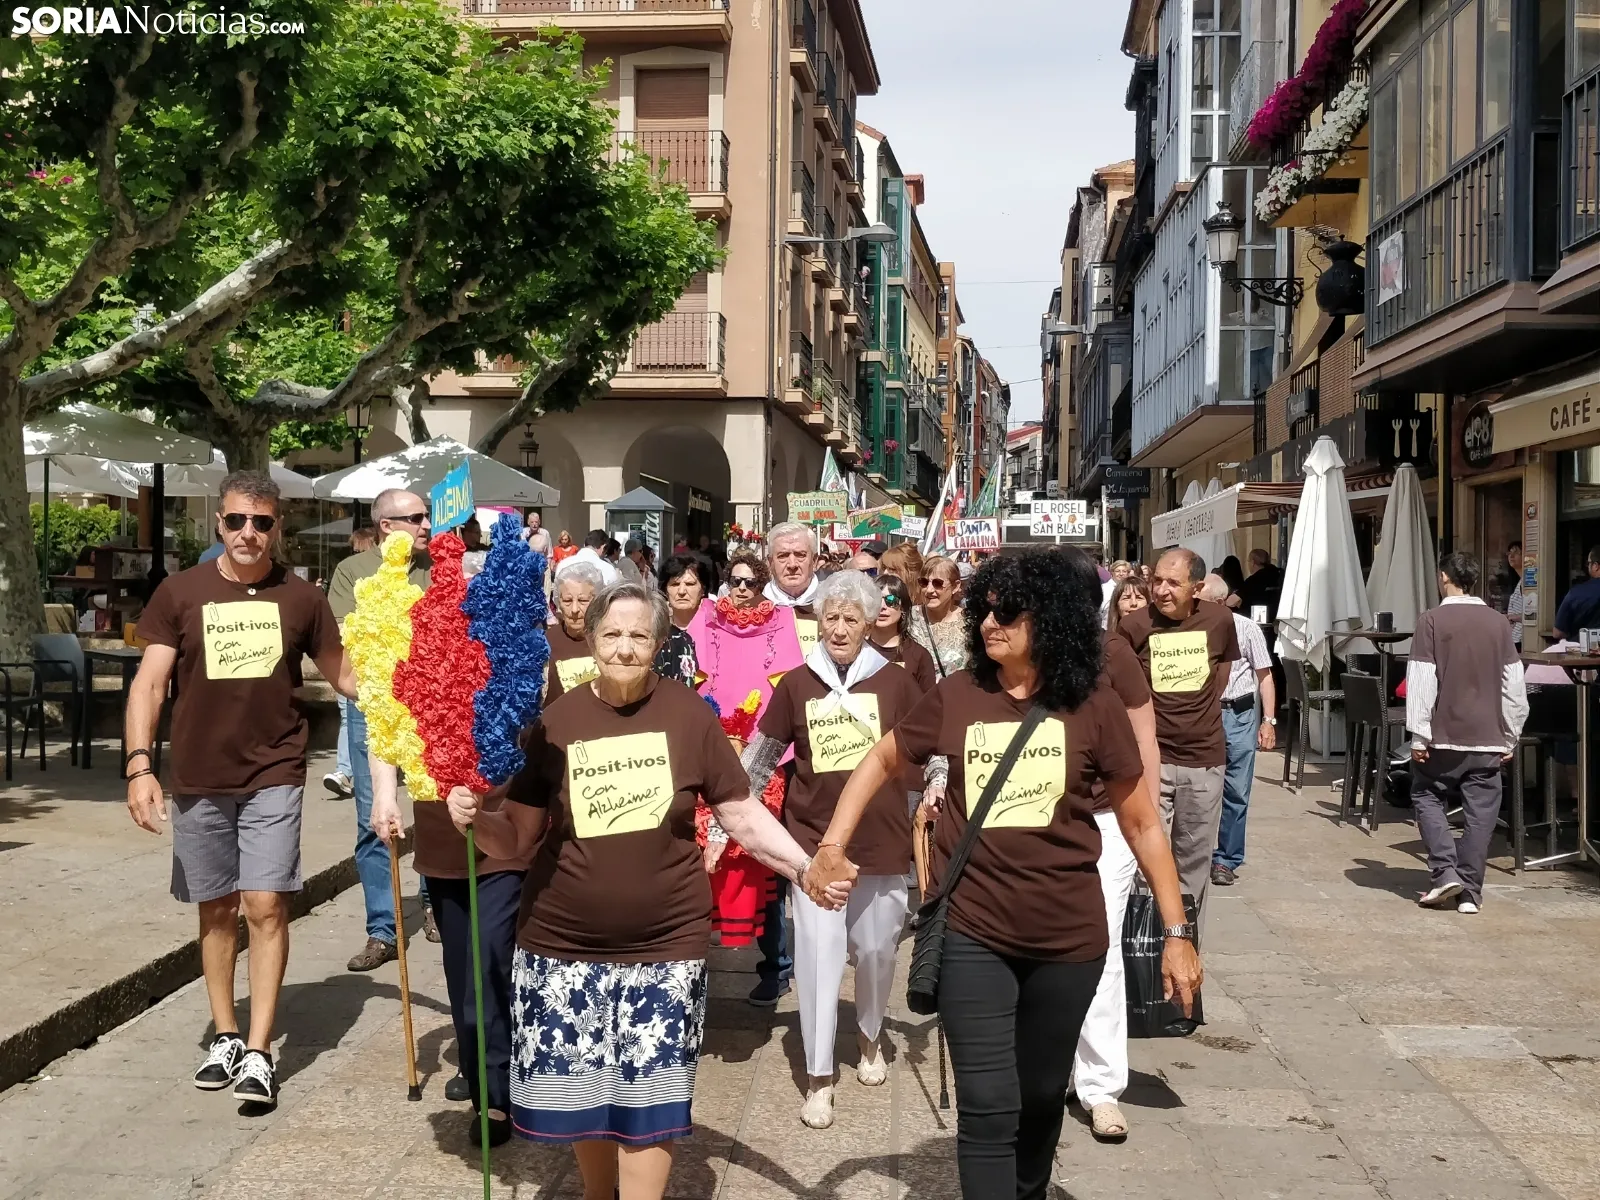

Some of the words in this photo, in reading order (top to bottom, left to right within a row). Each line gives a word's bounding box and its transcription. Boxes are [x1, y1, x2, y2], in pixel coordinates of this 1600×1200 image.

[1550, 392, 1591, 431] CAFÉ
[794, 499, 840, 508] CUADRILLA
[1033, 503, 1047, 513] EL
[1050, 502, 1084, 513] ROSEL
[957, 520, 992, 536] SANTA
[1033, 523, 1053, 534] SAN
[1057, 523, 1084, 534] BLAS
[954, 535, 997, 549] CATALINA
[206, 620, 279, 634] Posit-ivos
[214, 640, 242, 652] Con
[1152, 646, 1206, 658] Posit-ivos
[218, 646, 274, 667] Alzheimer
[1157, 662, 1178, 672] Con
[809, 712, 877, 730] Posit-is
[816, 733, 841, 745] Con
[820, 736, 873, 759] Alzheimer
[967, 746, 1063, 764] Pos-ivos
[572, 756, 667, 780] Posit-ivos
[582, 784, 618, 800] Con
[587, 786, 661, 819] Alzheimer
